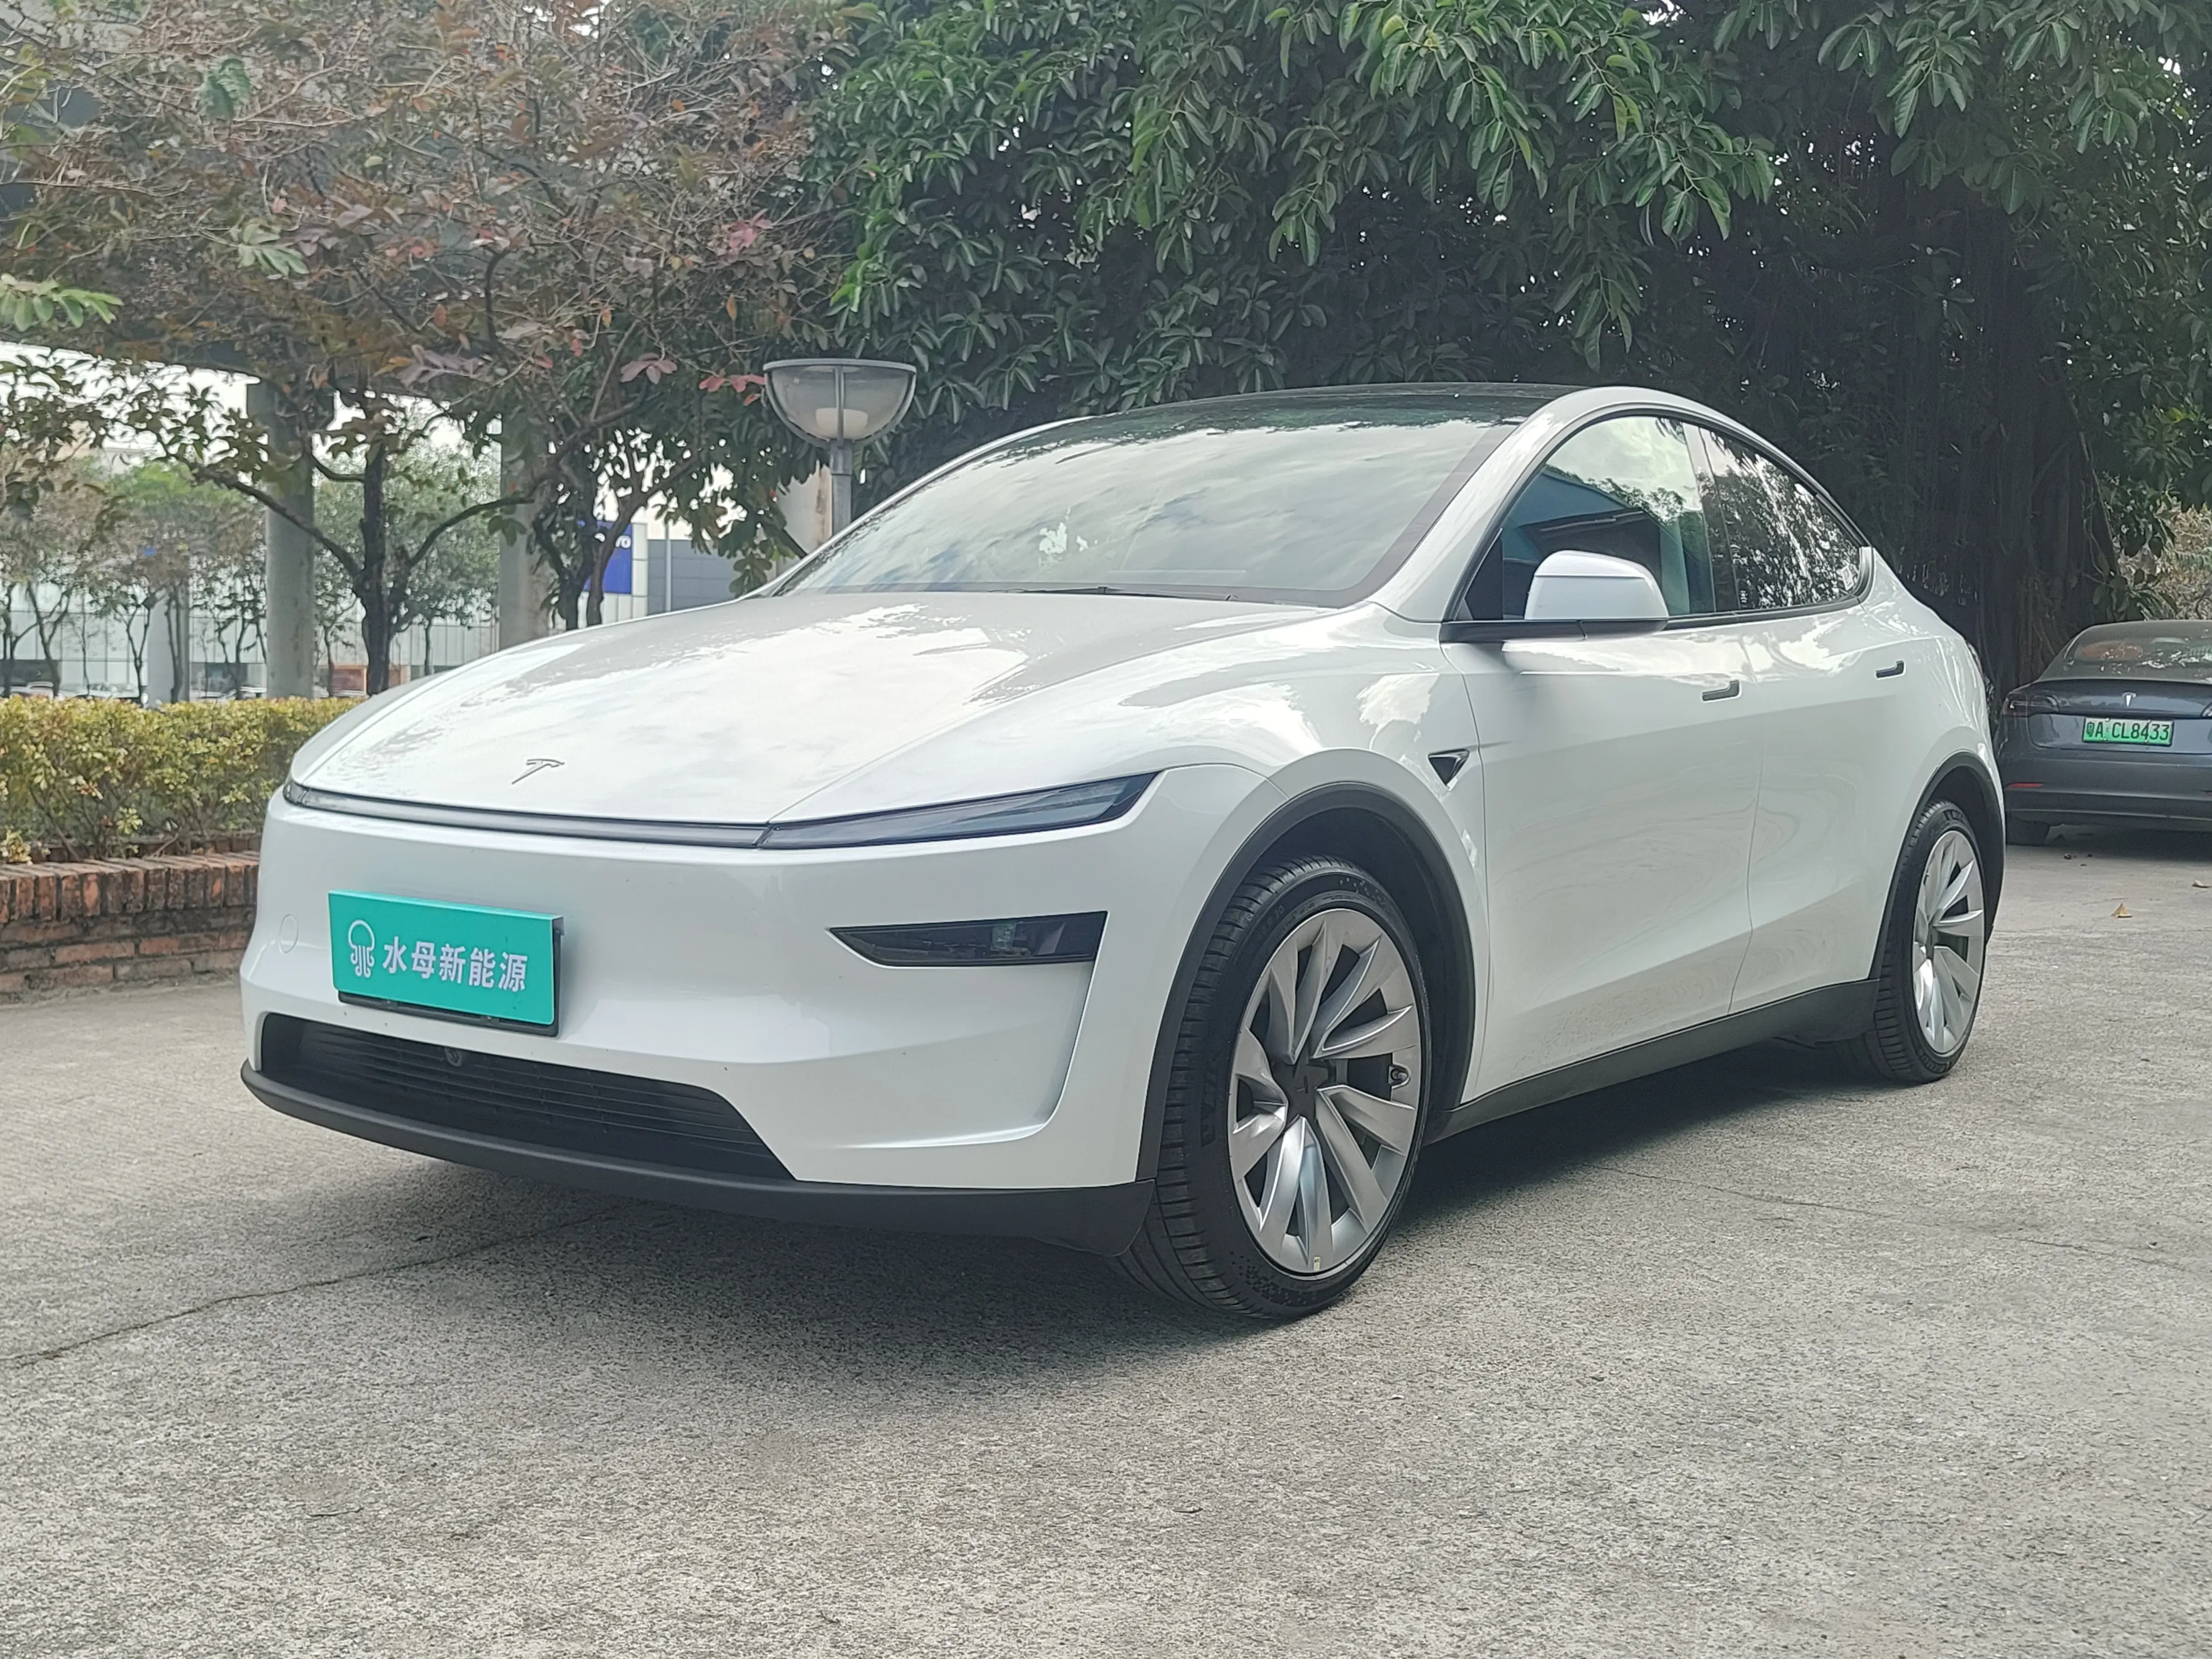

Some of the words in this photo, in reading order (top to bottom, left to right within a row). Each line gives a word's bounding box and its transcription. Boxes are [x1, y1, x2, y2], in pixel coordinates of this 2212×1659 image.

[2112, 721, 2170, 740] CL8433
[382, 936, 528, 992] 水母新能源
